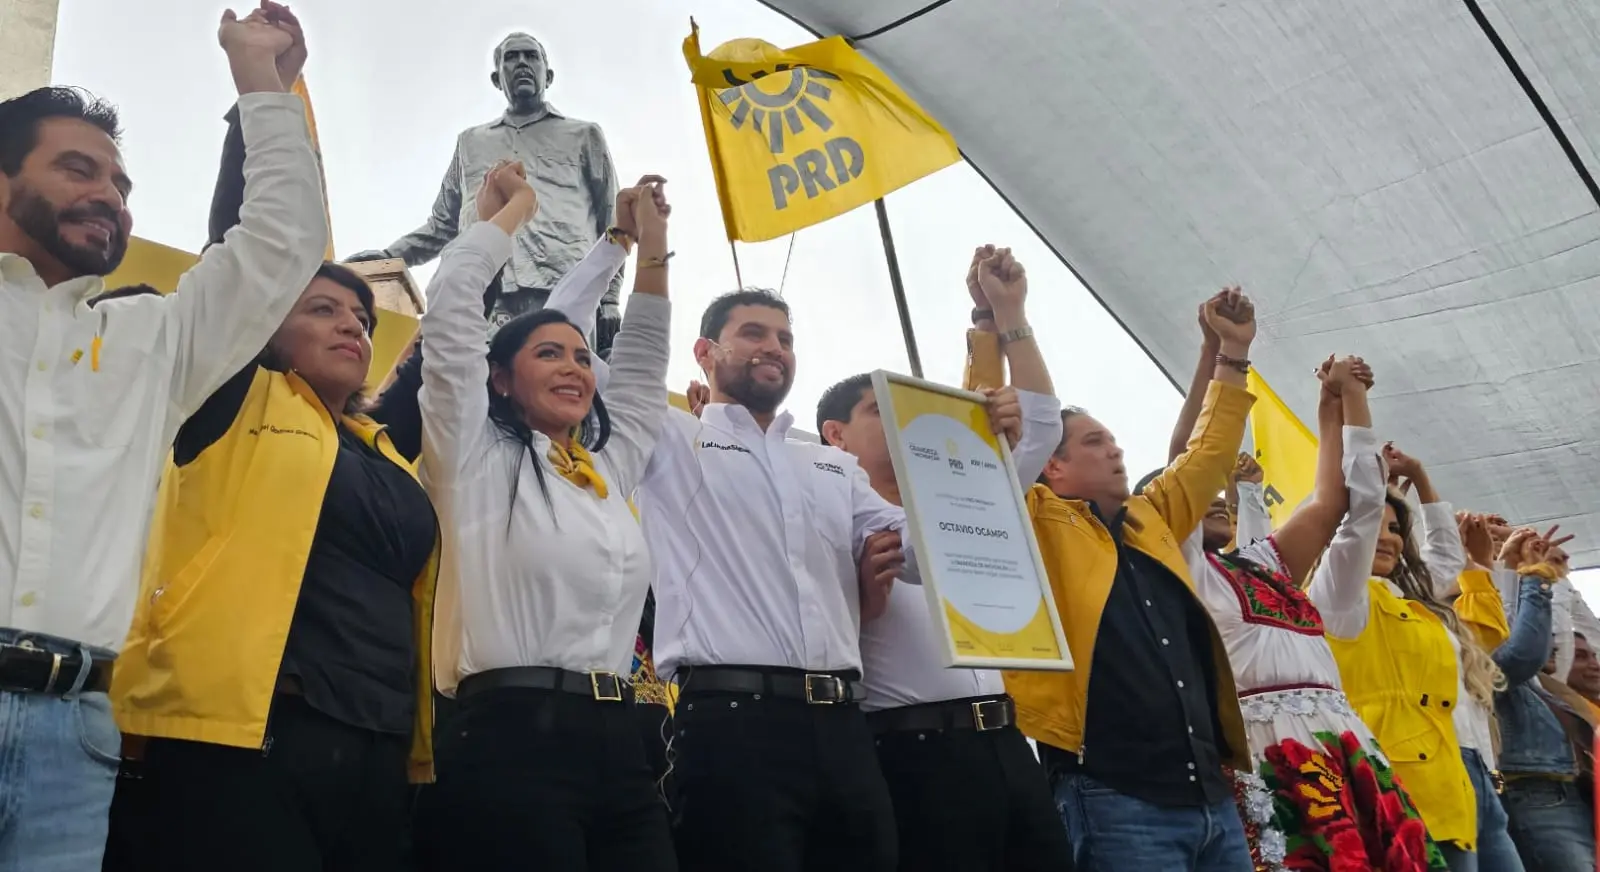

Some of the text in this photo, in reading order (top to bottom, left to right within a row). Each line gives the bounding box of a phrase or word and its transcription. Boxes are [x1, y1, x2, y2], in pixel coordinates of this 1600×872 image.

[767, 137, 865, 210] PRD
[938, 521, 1009, 540] OCTAVIO OCAMPO
